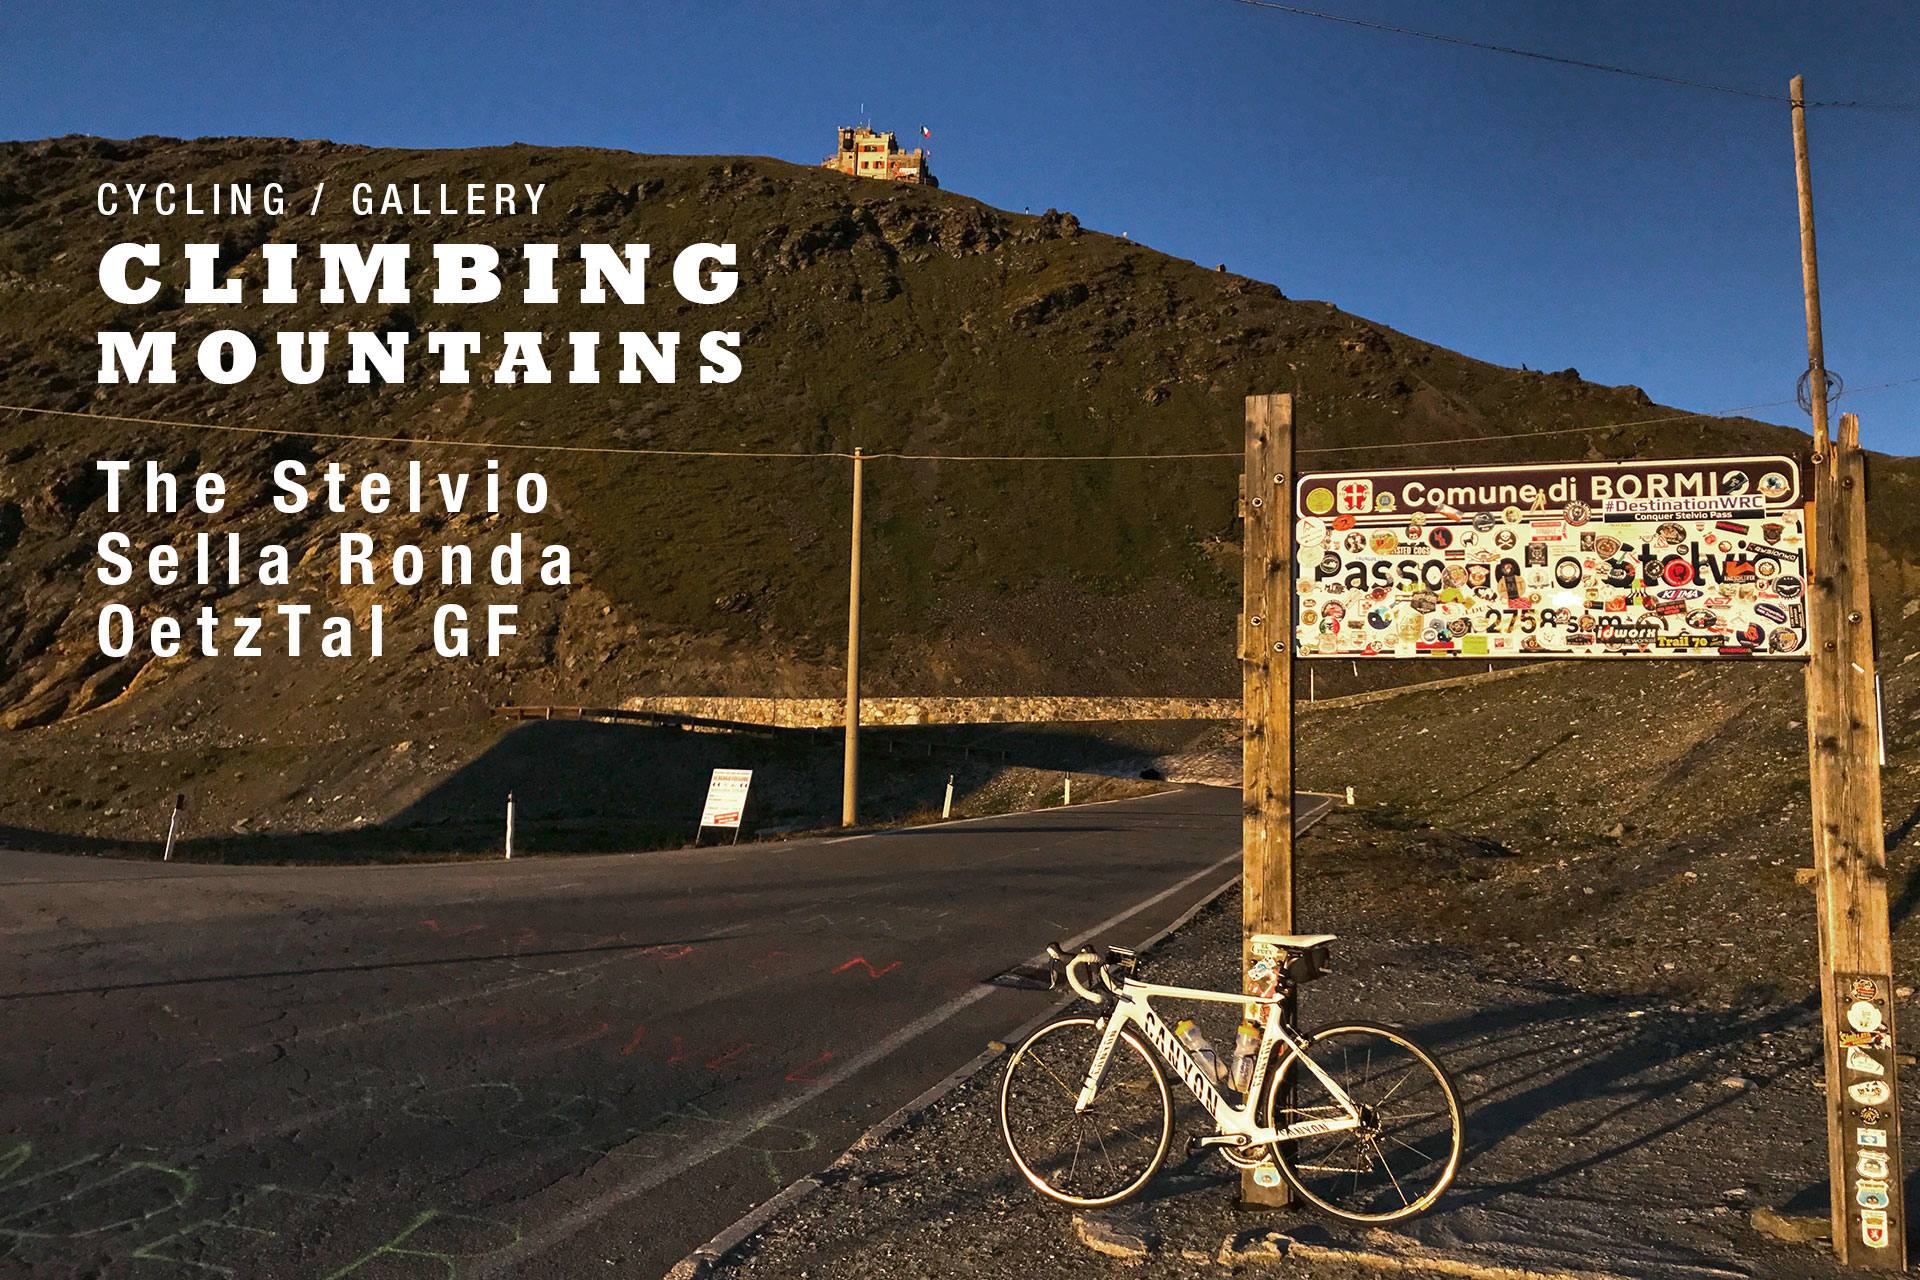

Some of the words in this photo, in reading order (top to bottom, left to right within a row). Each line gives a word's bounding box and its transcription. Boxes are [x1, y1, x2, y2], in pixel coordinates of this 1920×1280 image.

[1402, 481, 1537, 507] Comune
[1549, 476, 1577, 502] di
[1605, 495, 1763, 513] #DestinationWRC
[1634, 512, 1673, 521] Conquer
[1675, 511, 1708, 520] Stelvio
[1710, 511, 1733, 519] Pass
[1485, 608, 1557, 634] 2758
[1597, 626, 1657, 640] idworx
[1658, 636, 1689, 647] Trail
[1691, 637, 1708, 648] 70
[1144, 1012, 1218, 1117] CANYON
